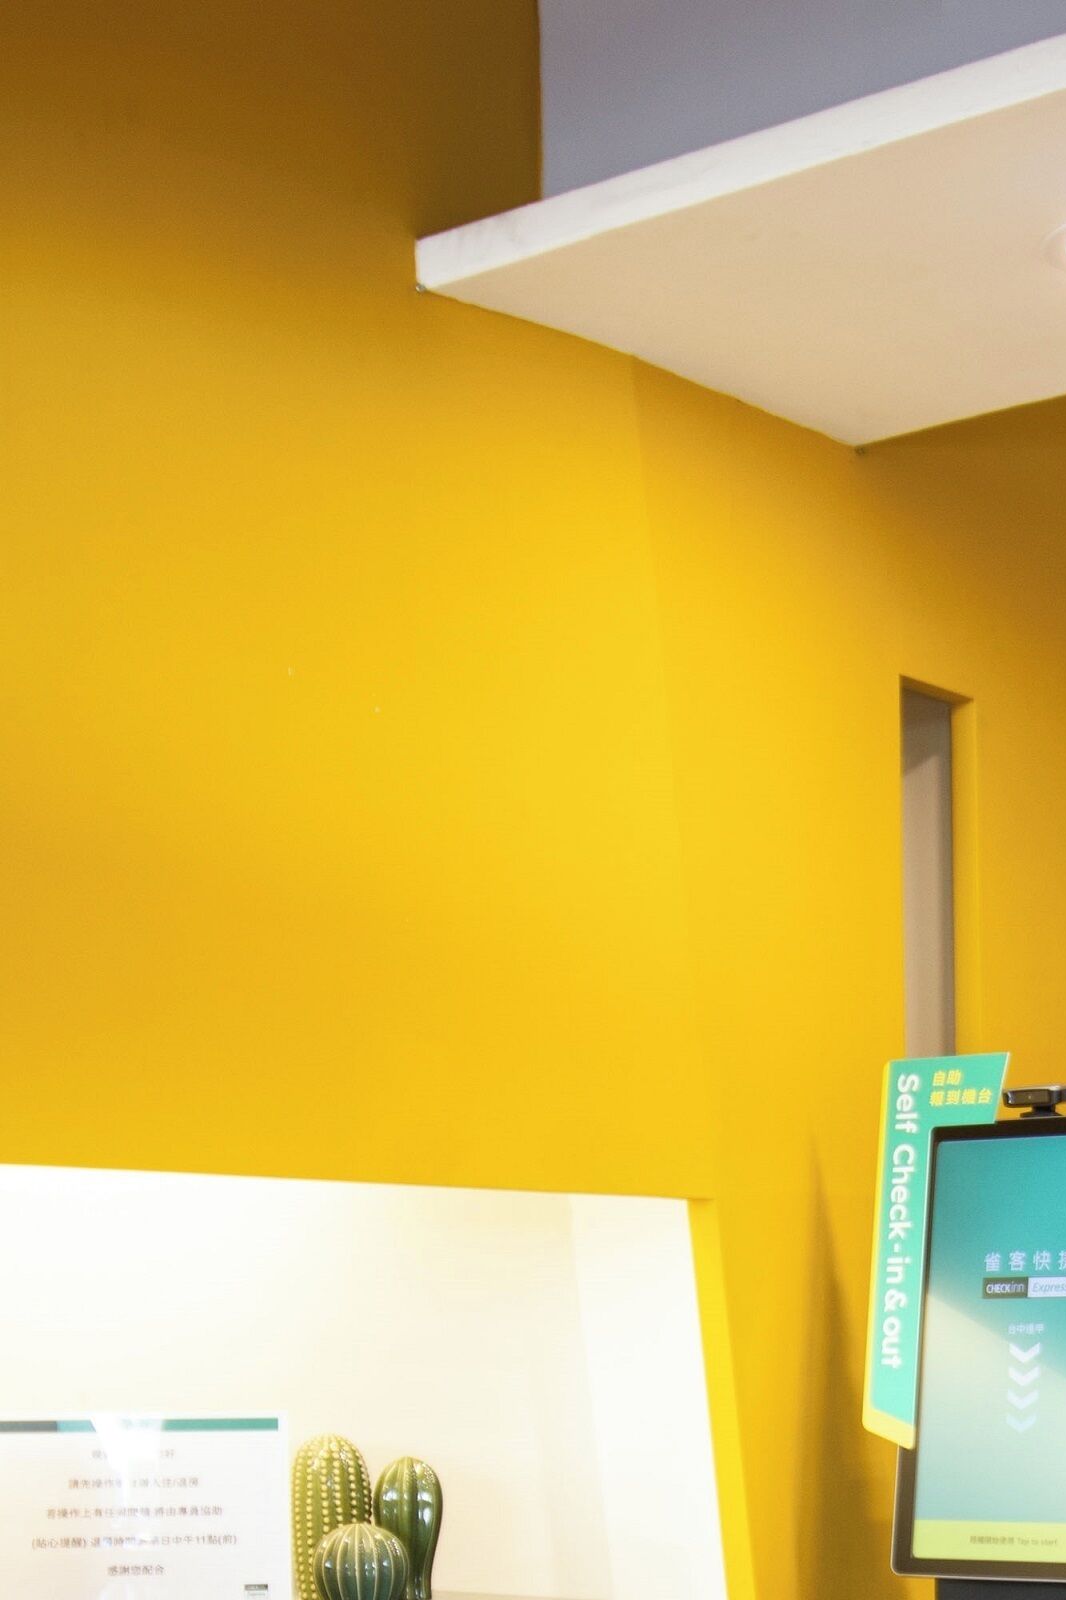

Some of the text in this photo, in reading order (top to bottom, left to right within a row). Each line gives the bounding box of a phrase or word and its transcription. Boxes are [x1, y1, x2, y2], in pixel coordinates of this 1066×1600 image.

[895, 1074, 920, 1133] Self
[932, 1070, 962, 1086] 自助
[886, 1144, 915, 1283] Check-in
[881, 1317, 902, 1368] out
